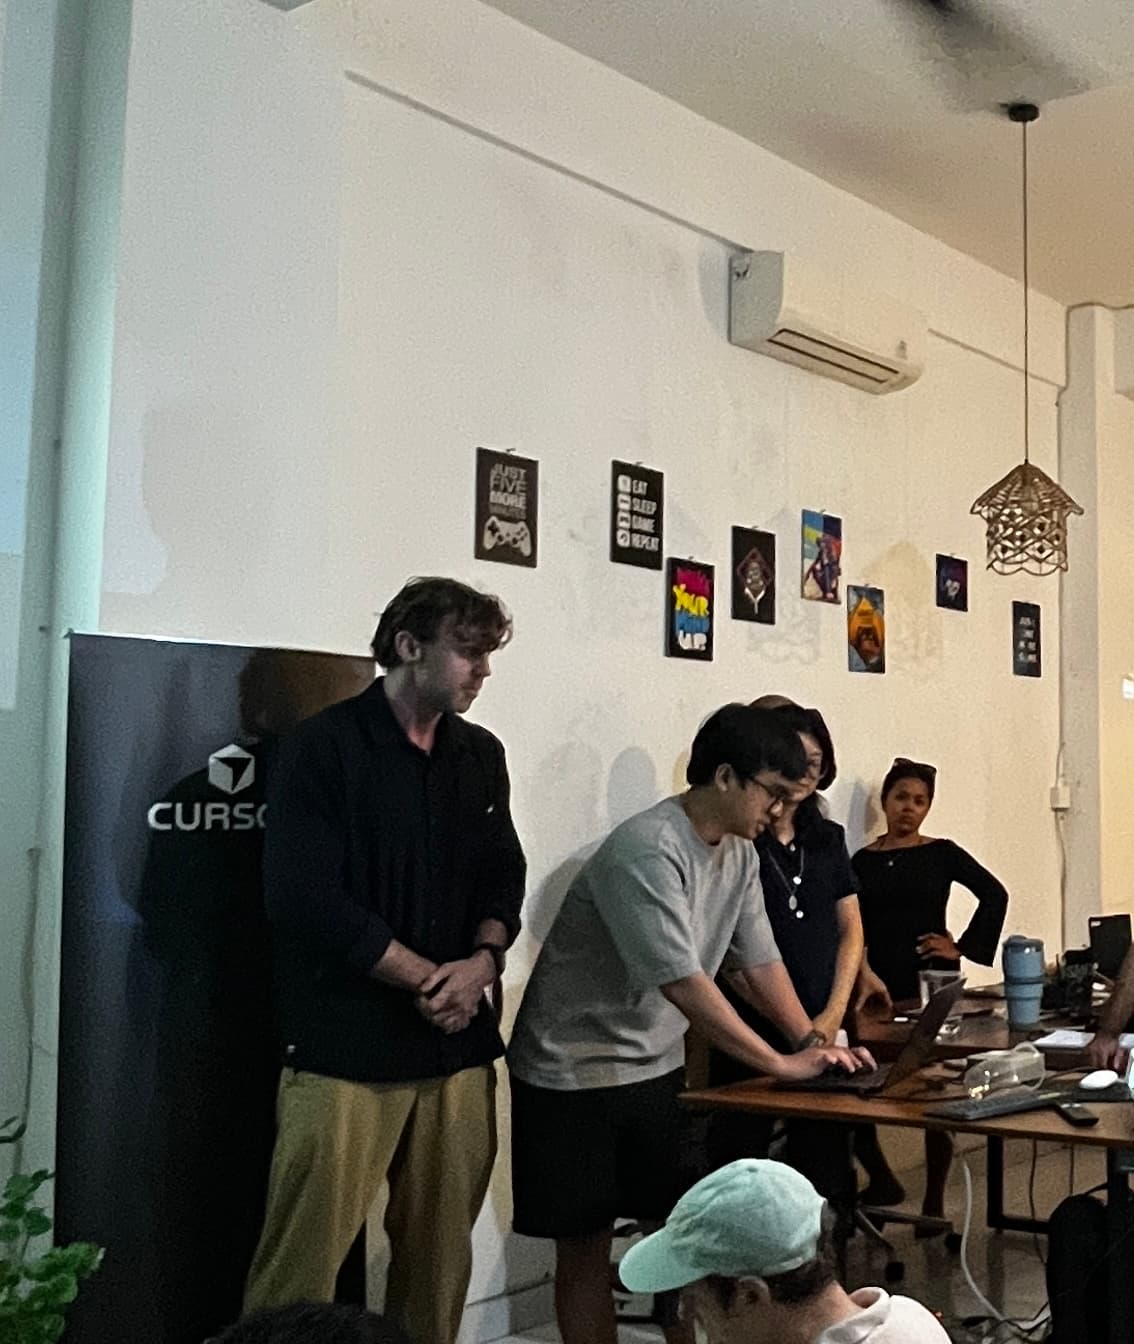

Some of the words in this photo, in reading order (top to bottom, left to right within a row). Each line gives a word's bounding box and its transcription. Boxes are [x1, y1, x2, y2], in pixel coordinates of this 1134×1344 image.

[491, 464, 527, 480] JUST
[490, 471, 527, 496] FIVE
[632, 479, 648, 495] EAT
[489, 491, 527, 509] MORE
[632, 497, 657, 515] SLEEP
[631, 533, 660, 552] REPEAT
